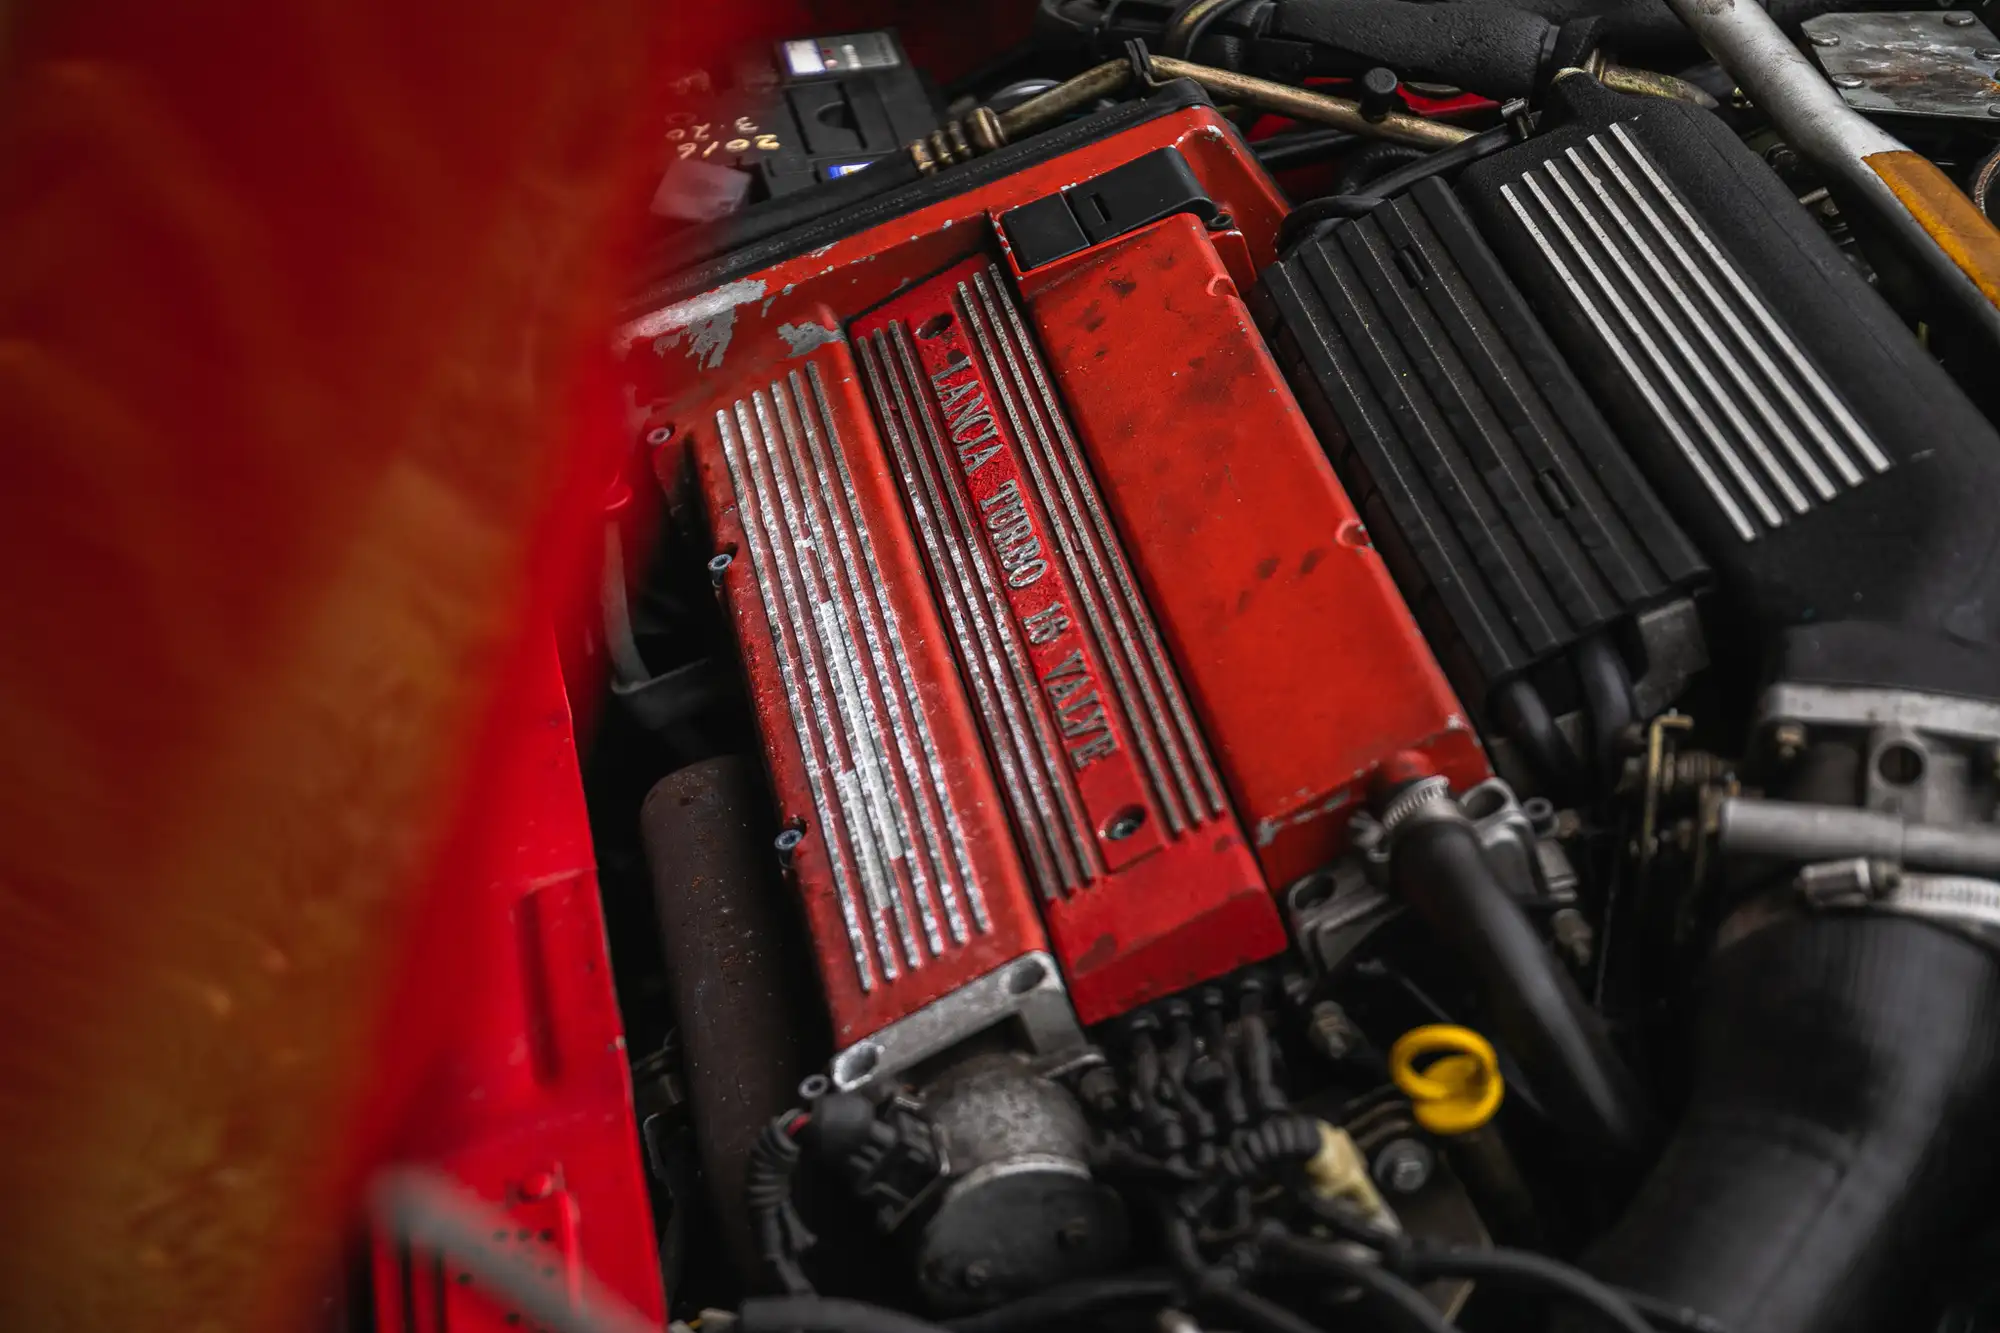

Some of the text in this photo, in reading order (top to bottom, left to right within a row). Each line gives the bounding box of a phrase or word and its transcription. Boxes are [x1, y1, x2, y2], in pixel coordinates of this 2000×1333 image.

[677, 133, 781, 159] 2016
[932, 357, 1117, 769] LANCIA TURBO 16 VALVE
